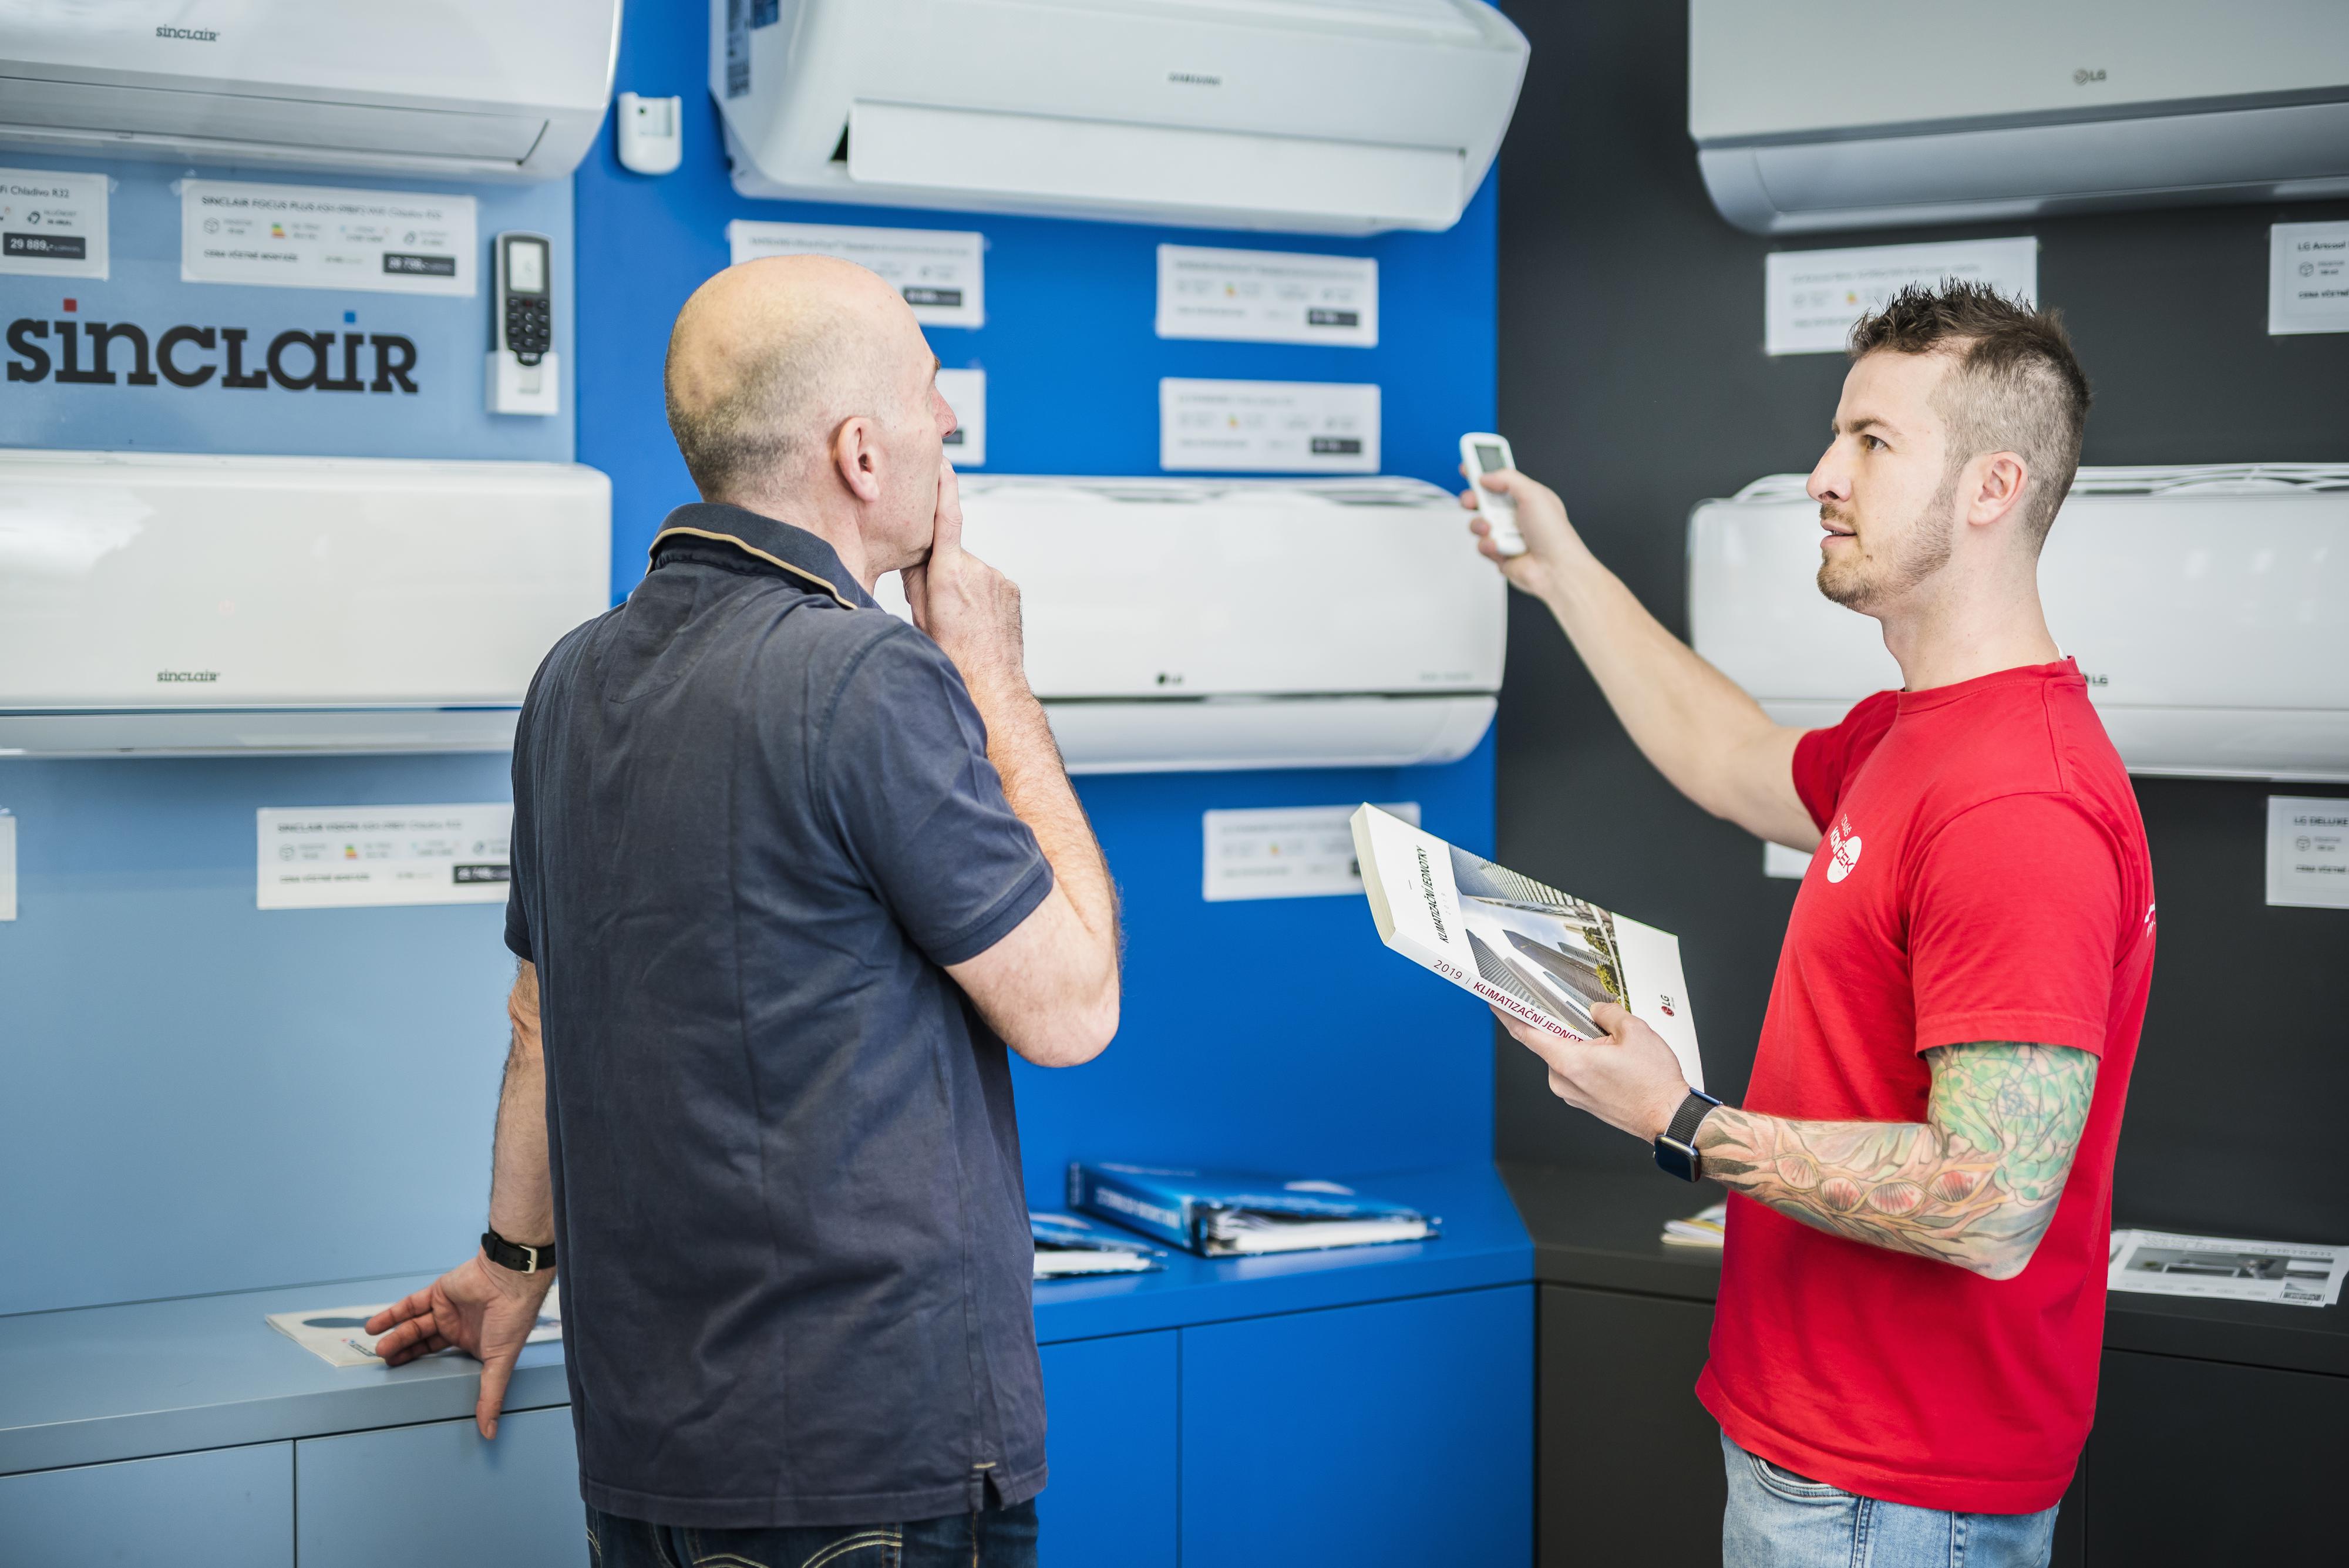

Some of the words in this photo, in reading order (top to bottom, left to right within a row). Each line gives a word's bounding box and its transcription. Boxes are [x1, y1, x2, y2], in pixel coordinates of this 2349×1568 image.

[2089, 69, 2106, 81] LG
[11, 185, 49, 197] Chladivo
[52, 188, 69, 198] R32
[202, 196, 249, 207] SINCLAIR
[252, 198, 287, 210] FOCUS
[11, 238, 24, 250] 29
[2298, 242, 2311, 251] LG
[2092, 675, 2108, 686] LG
[2294, 815, 2307, 826] LG
[2310, 816, 2349, 827] DELUXE
[1416, 845, 1433, 890] JEDNOTKY
[1421, 885, 1449, 943] KLIMATIZAČNÍ
[1433, 960, 1463, 980] 2019
[1473, 981, 1546, 1025] KLIMATIZAČNÍ
